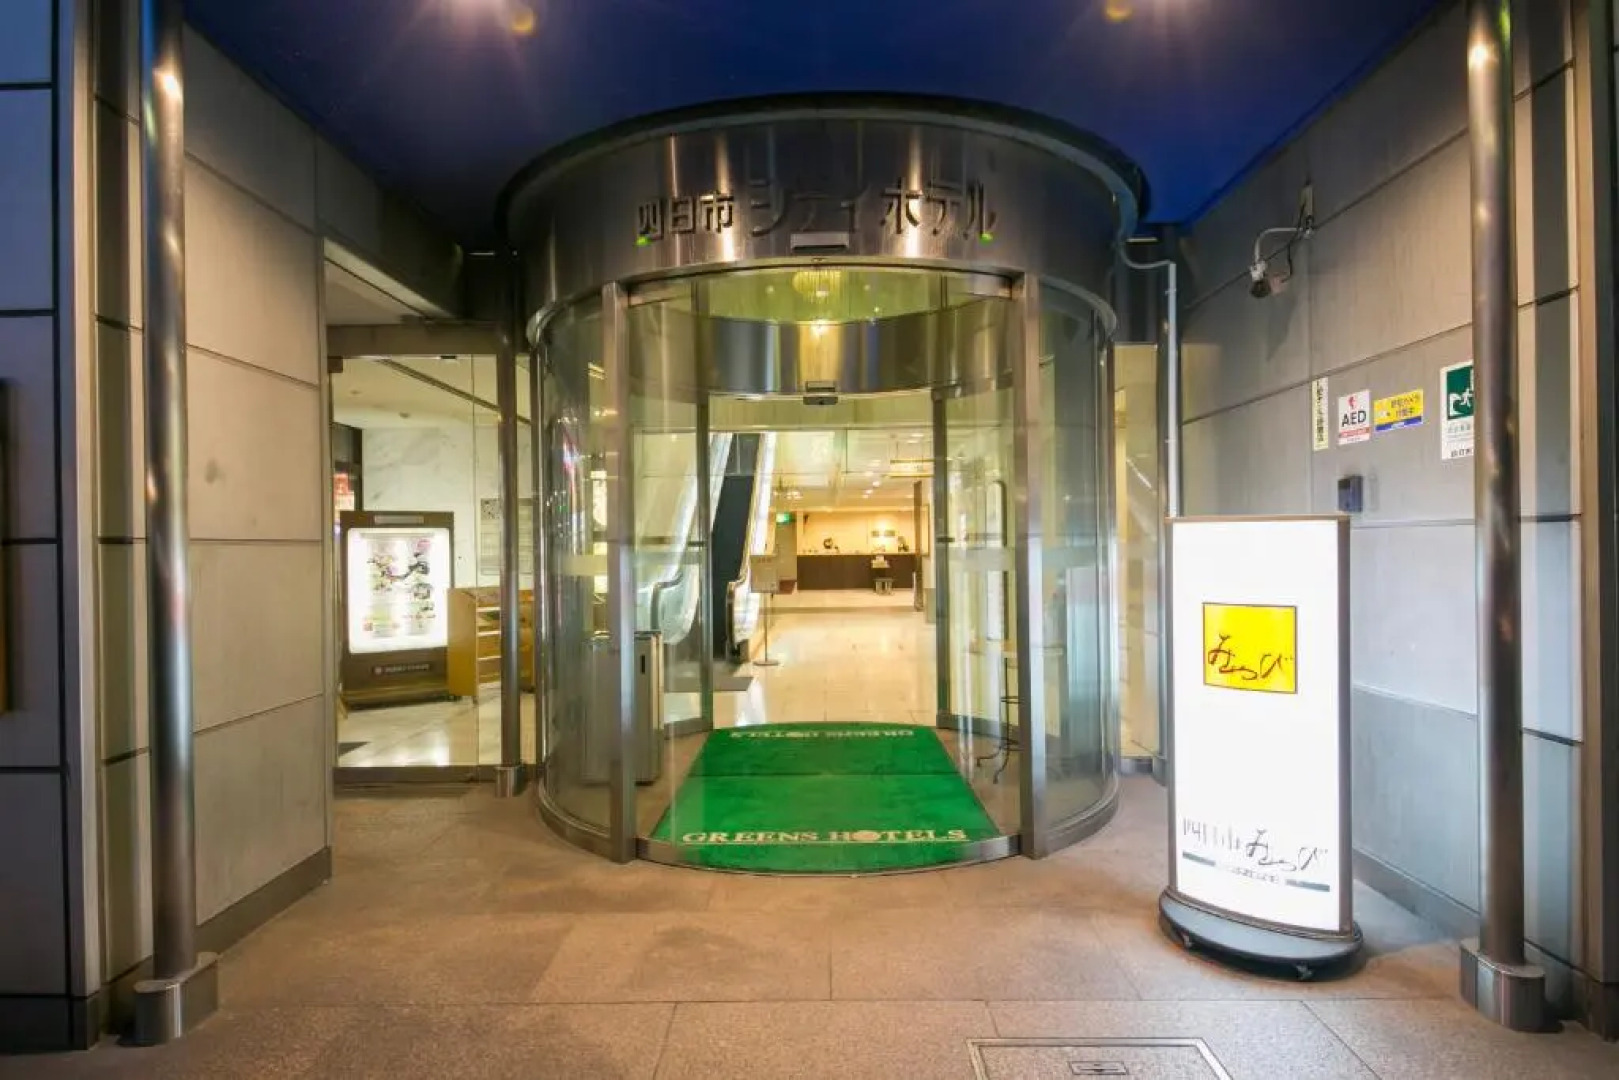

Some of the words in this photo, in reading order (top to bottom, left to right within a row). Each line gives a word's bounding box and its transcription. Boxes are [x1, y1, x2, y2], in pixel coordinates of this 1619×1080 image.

[1341, 410, 1367, 428] AED
[682, 831, 820, 843] GREENS
[829, 829, 968, 842] HOTELS
